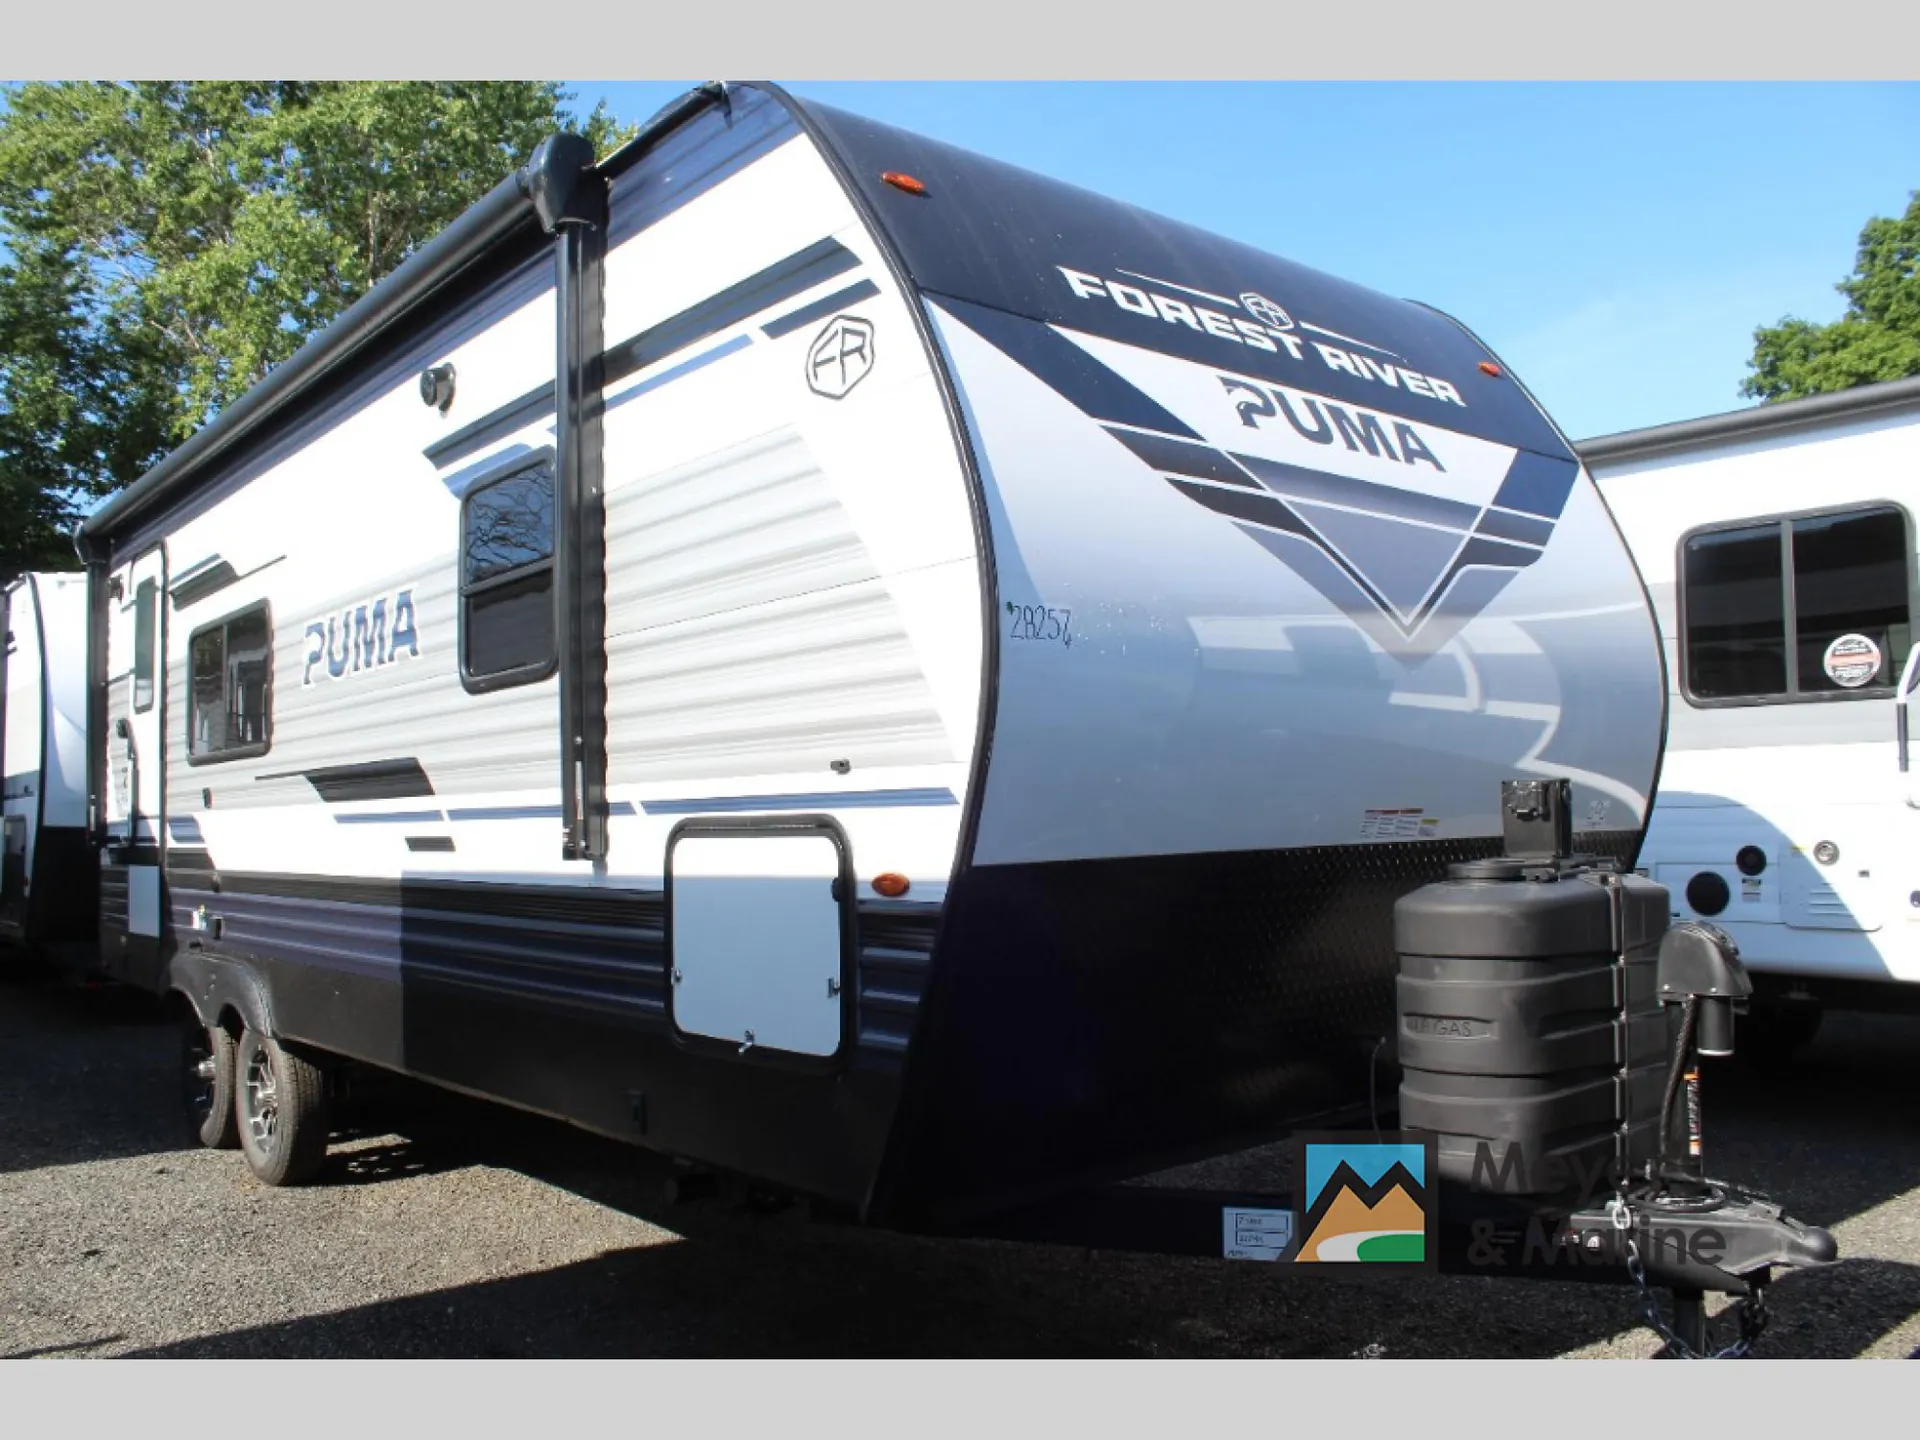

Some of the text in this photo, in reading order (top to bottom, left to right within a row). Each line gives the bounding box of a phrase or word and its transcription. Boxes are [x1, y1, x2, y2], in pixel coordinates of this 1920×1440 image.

[1056, 265, 1468, 408] FOREST RIVER
[1216, 374, 1447, 472] PUMA
[303, 588, 419, 686] PUMA
[1433, 1018, 1472, 1038] GAS
